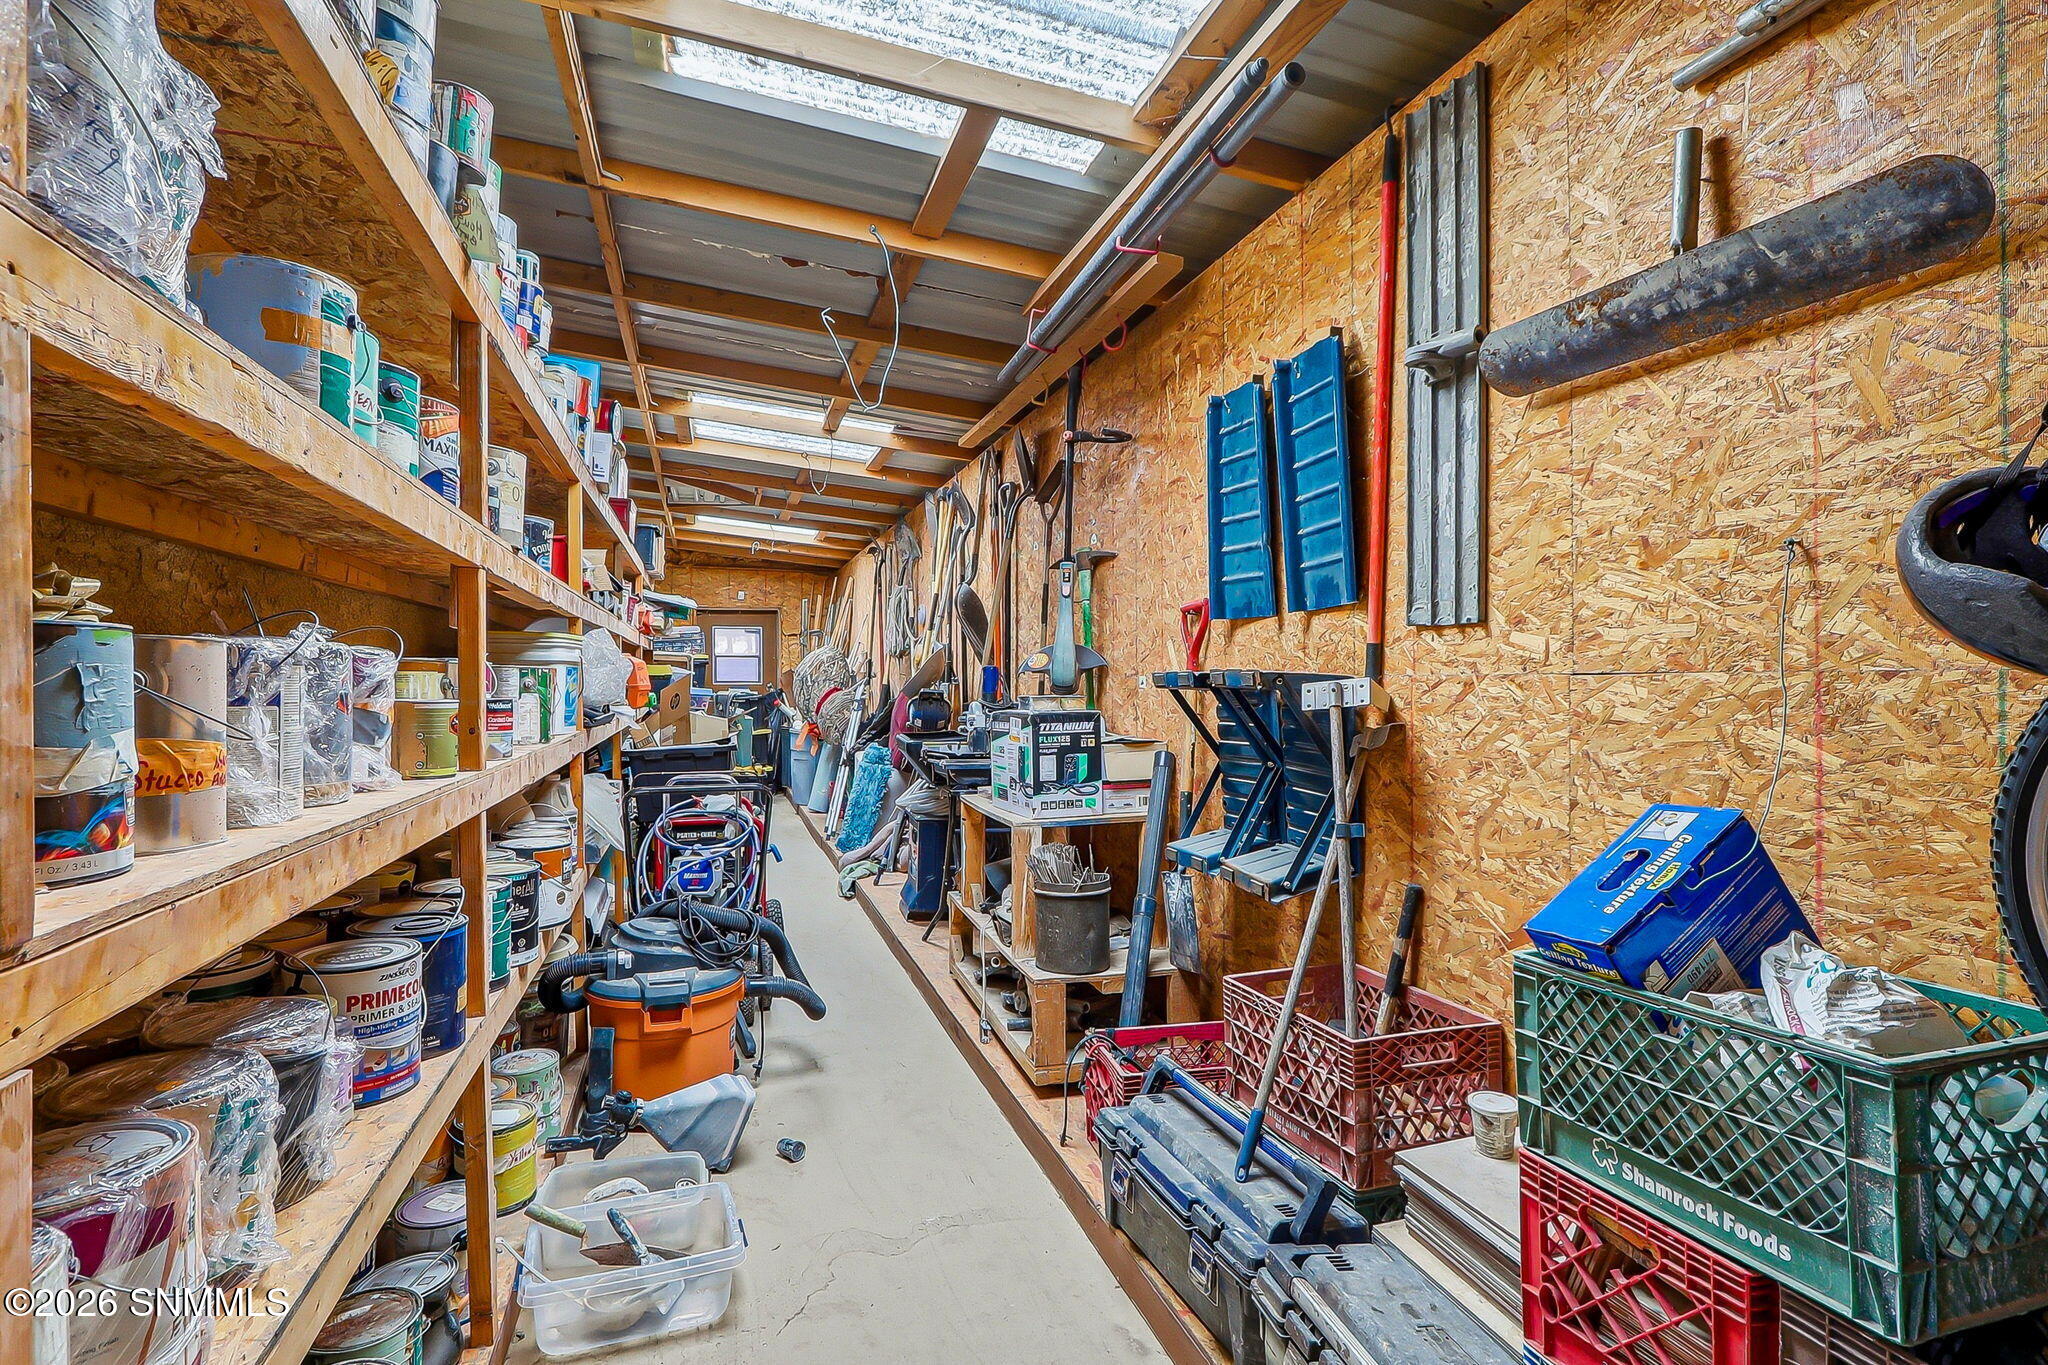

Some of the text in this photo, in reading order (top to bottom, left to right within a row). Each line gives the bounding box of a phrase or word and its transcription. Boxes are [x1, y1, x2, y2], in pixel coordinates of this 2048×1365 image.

[502, 276, 520, 293] KIL
[1039, 721, 1095, 733] TITANIUM
[134, 760, 205, 792] Stucco
[1653, 833, 1692, 873] Ceiling
[1602, 870, 1657, 915] Texture
[378, 967, 411, 983] ZINSSER
[351, 1008, 395, 1023] PRIMER
[398, 1005, 406, 1014] &
[1621, 1162, 1793, 1263] Shamrock Foods
